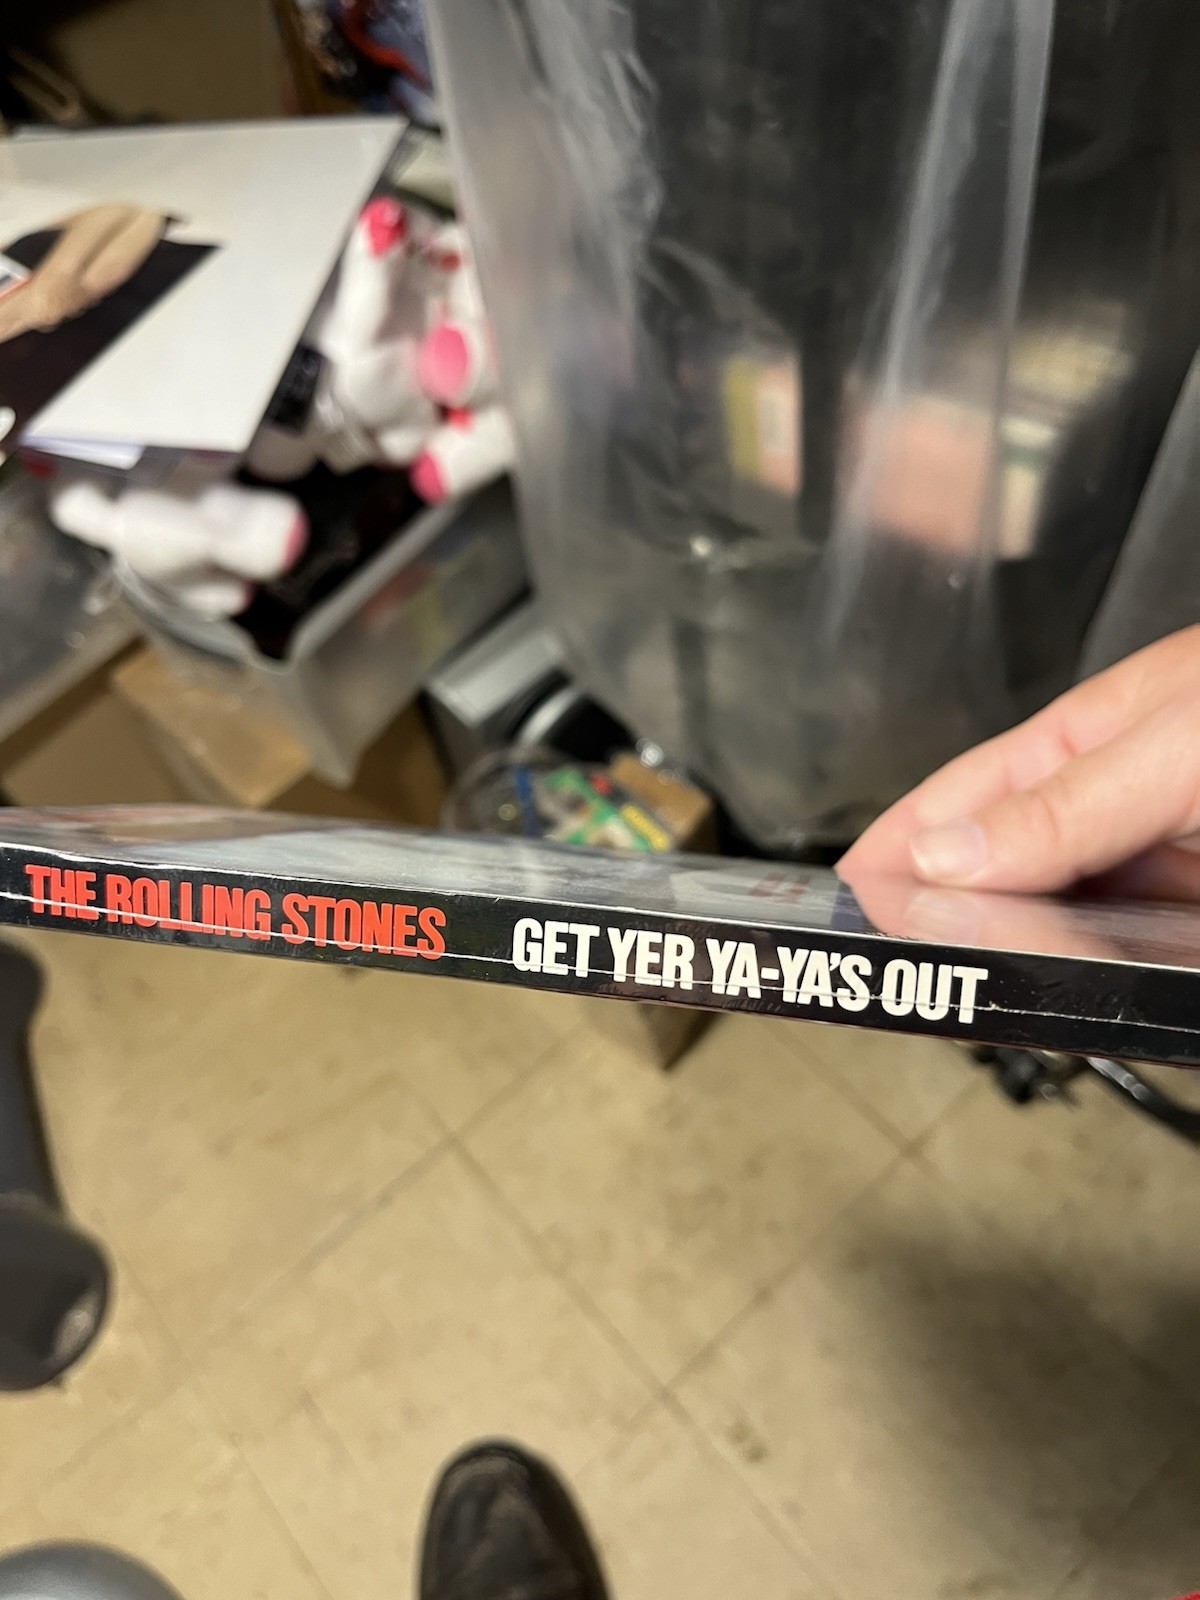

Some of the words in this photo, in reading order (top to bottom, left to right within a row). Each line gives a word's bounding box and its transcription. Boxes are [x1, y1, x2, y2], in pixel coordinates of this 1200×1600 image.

[25, 864, 99, 921] THE
[105, 874, 271, 941] ROLLING
[281, 893, 447, 960] STONES
[512, 917, 600, 977] GET
[606, 926, 695, 990] YER
[706, 938, 872, 1012] YA-YA'S
[880, 959, 988, 1024] OUT
